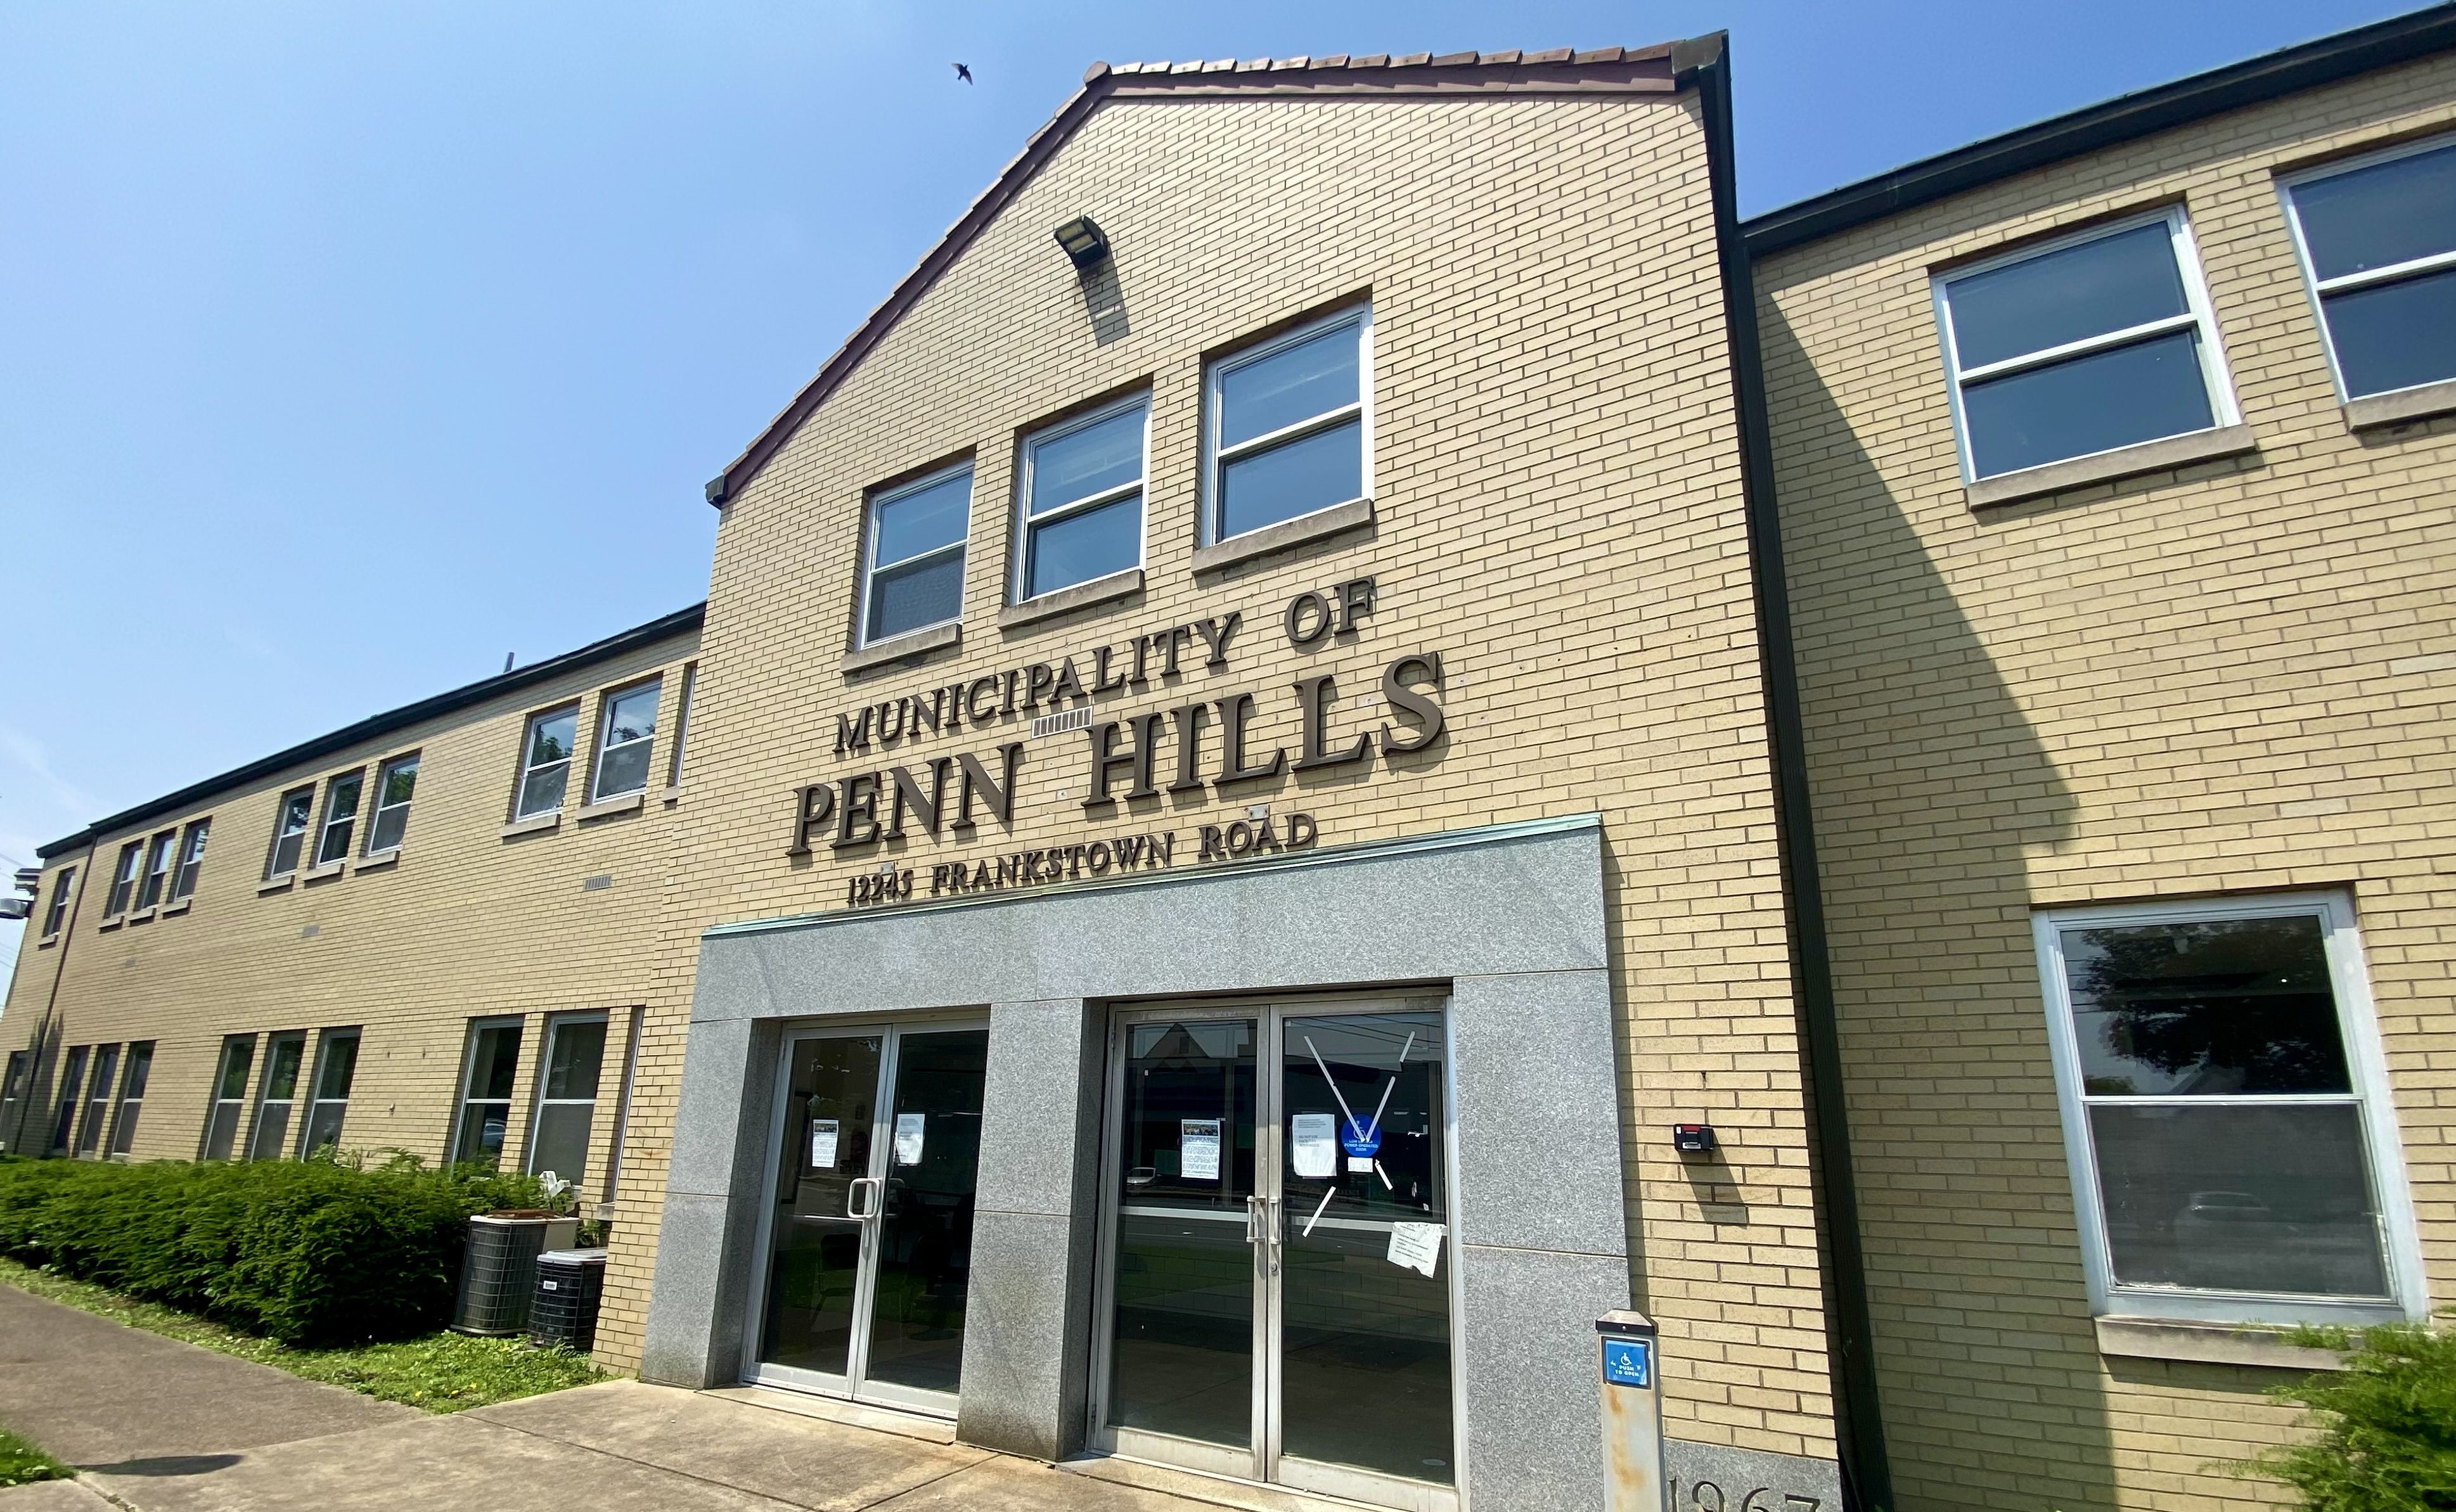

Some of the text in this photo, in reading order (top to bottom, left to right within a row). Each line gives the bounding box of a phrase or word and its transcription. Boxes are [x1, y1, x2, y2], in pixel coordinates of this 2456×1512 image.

[832, 575, 1375, 752] MUNICIPALITY OF
[785, 651, 1443, 857] PENN HILLS
[847, 813, 1316, 903] 12245 FRANKSTOWN ROAD
